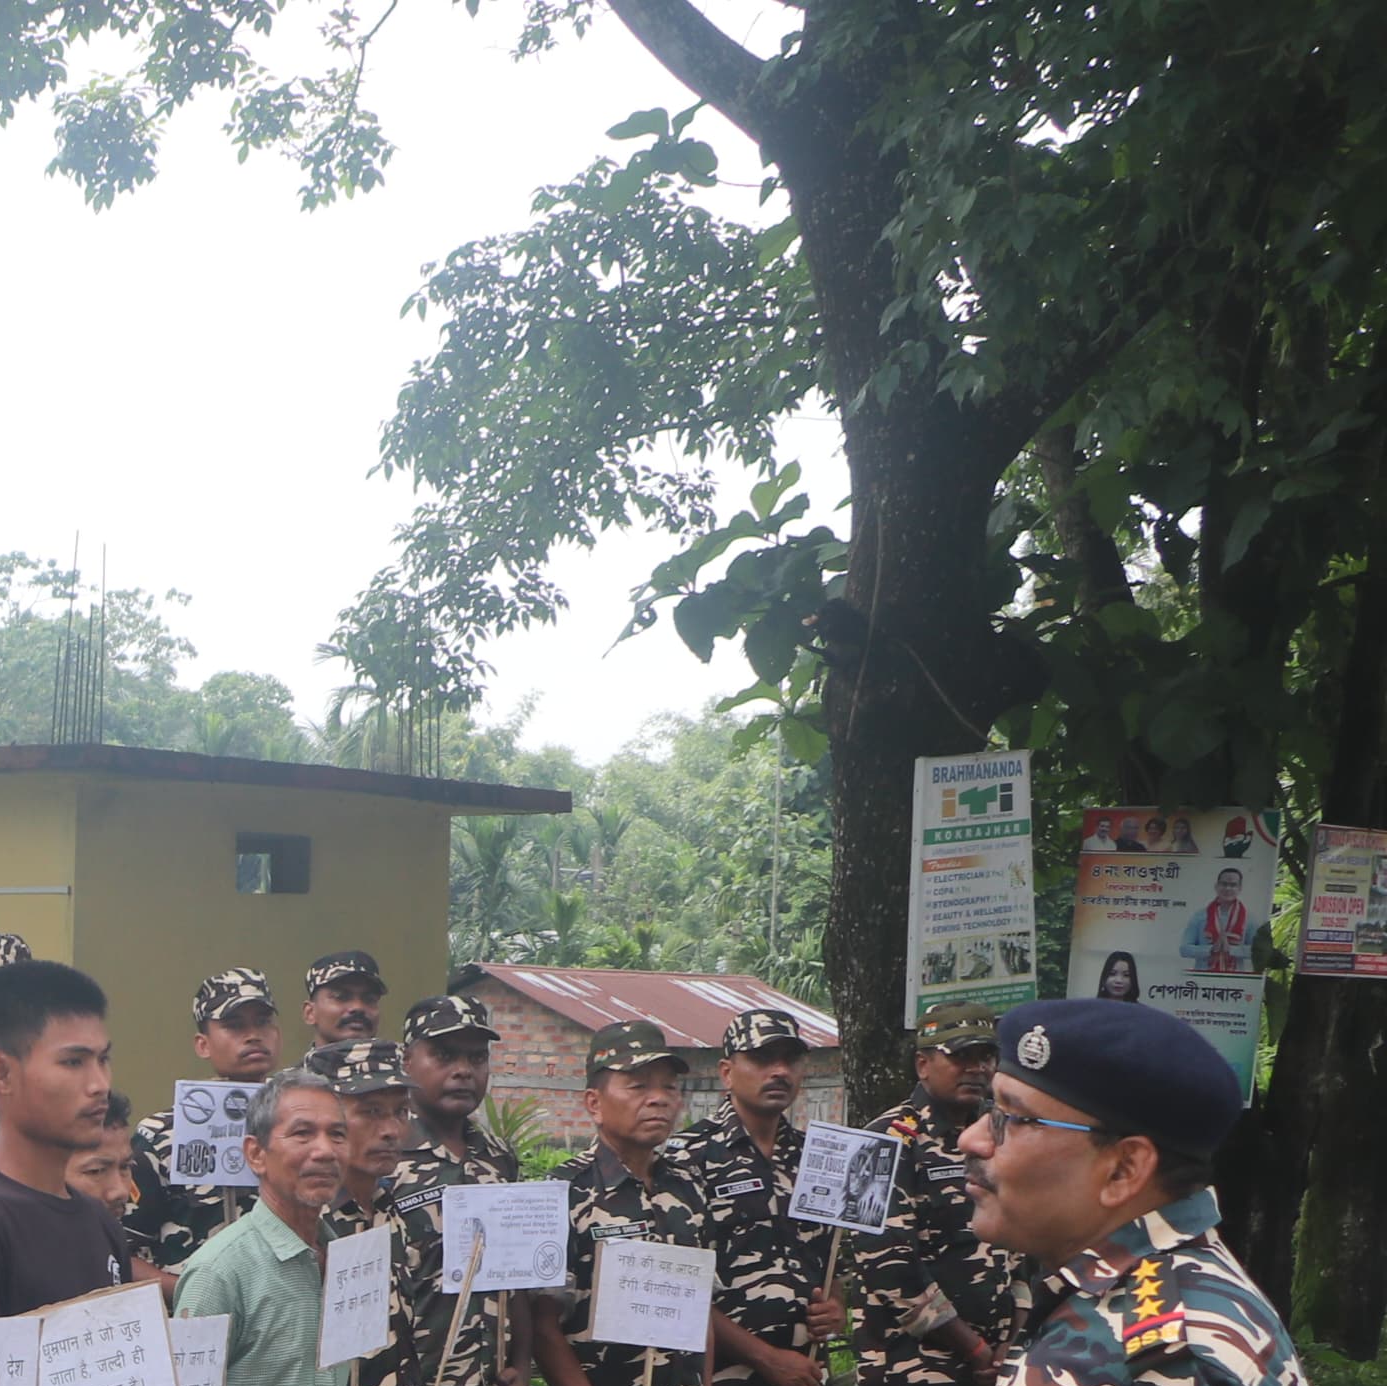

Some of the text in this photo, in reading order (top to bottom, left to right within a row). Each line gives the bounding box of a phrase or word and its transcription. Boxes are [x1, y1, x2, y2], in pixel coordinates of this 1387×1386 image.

[932, 760, 1023, 784] BRAHMANANDA
[934, 824, 1020, 841] KOKRAJHAR
[933, 871, 986, 884] ELECTRICIAN
[932, 895, 990, 909] STENOGRAPHY
[932, 911, 963, 922] BEAUTY
[176, 1143, 217, 1174] DRUGS
[486, 1266, 533, 1280] drug abuse
[83, 1329, 93, 1346] से
[98, 1321, 114, 1342] जो
[7, 1353, 24, 1378] देश
[49, 1368, 76, 1386] जाता
[95, 1349, 125, 1373] जल्दी
[131, 1344, 145, 1364] ही
